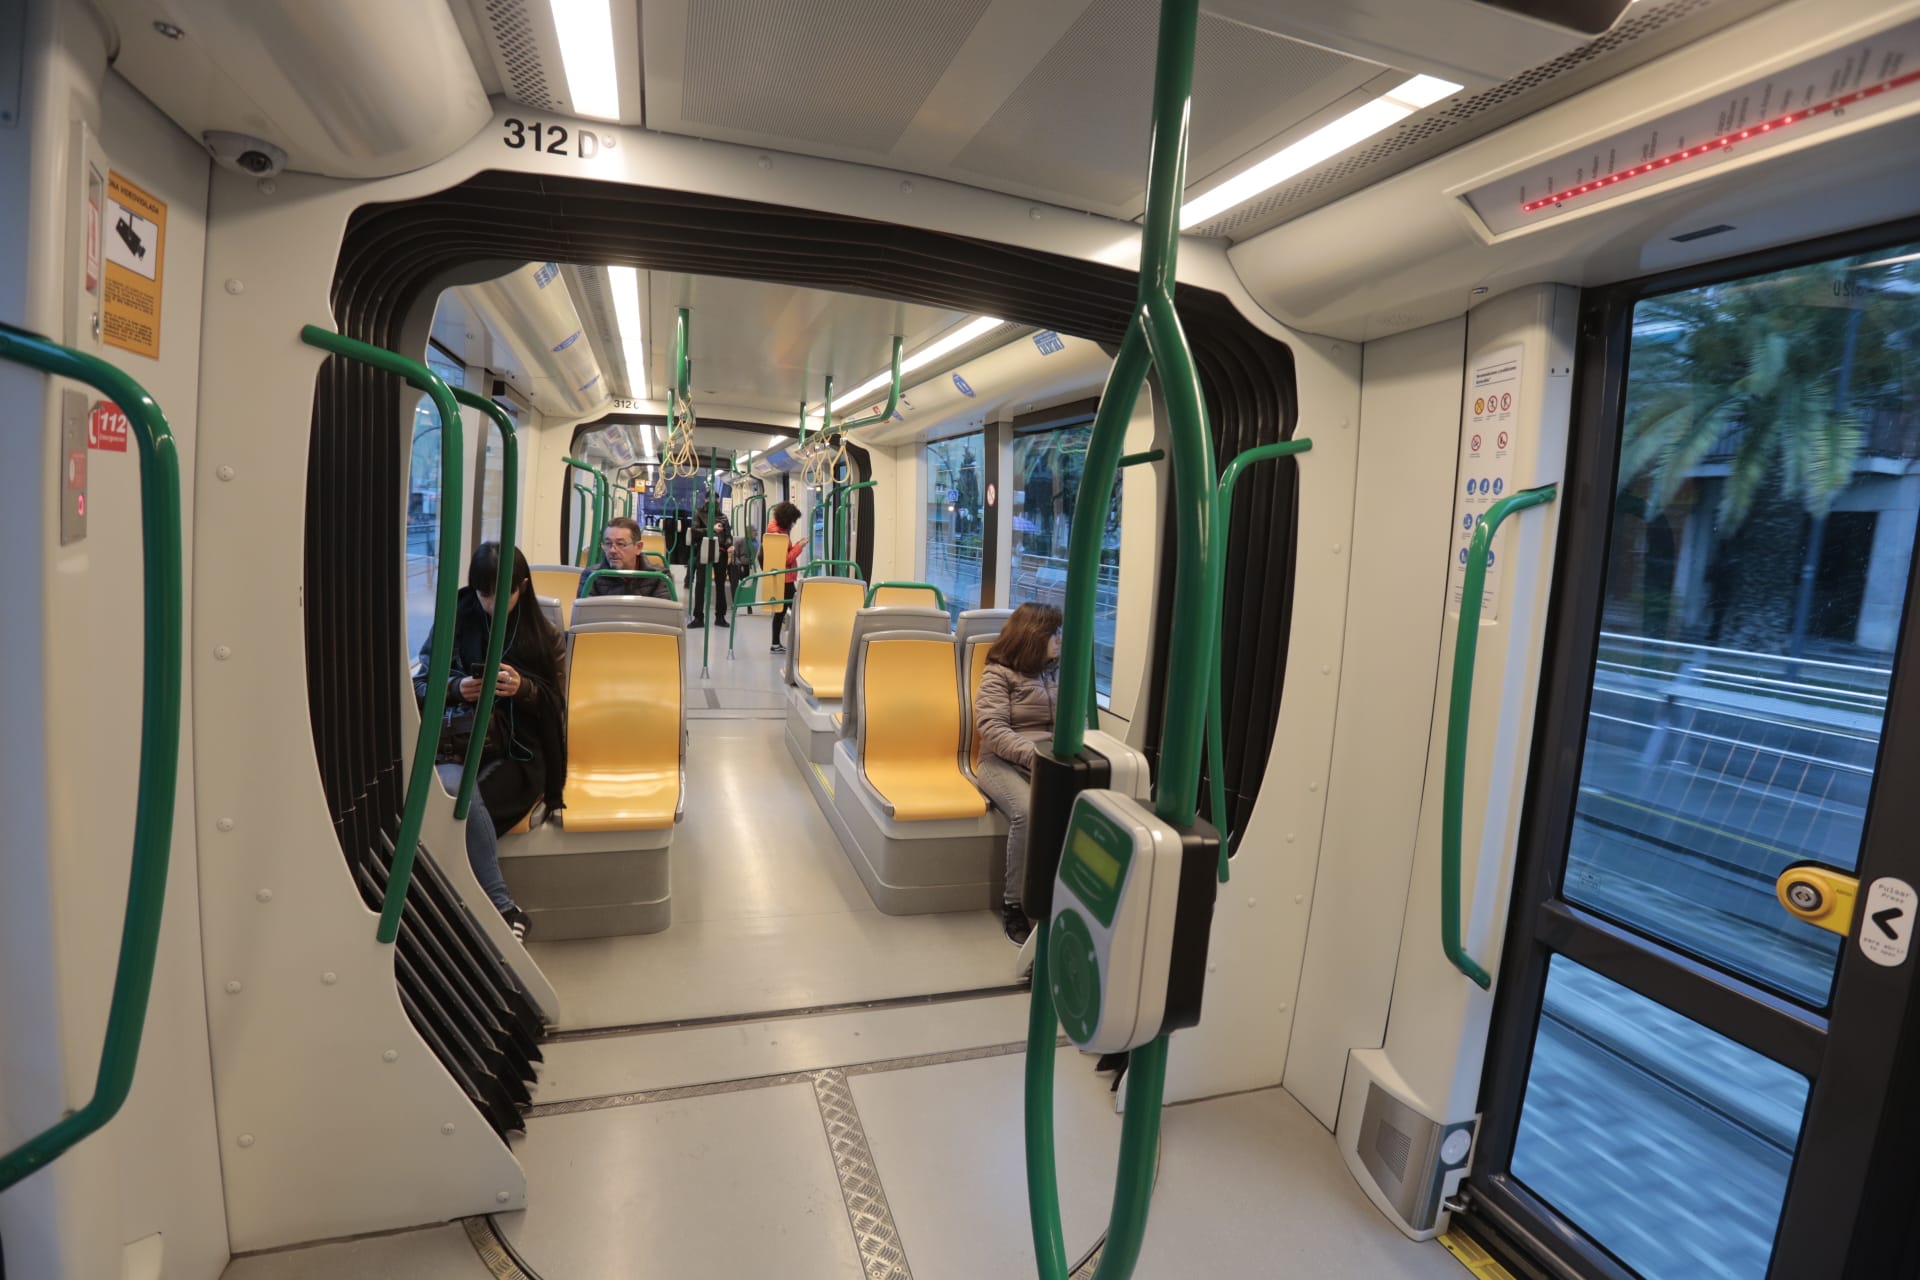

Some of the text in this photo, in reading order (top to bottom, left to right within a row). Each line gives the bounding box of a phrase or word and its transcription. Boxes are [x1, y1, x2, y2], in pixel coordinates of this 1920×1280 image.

[503, 118, 599, 158] 312 D
[614, 399, 632, 409] 312
[100, 412, 127, 433] 112
